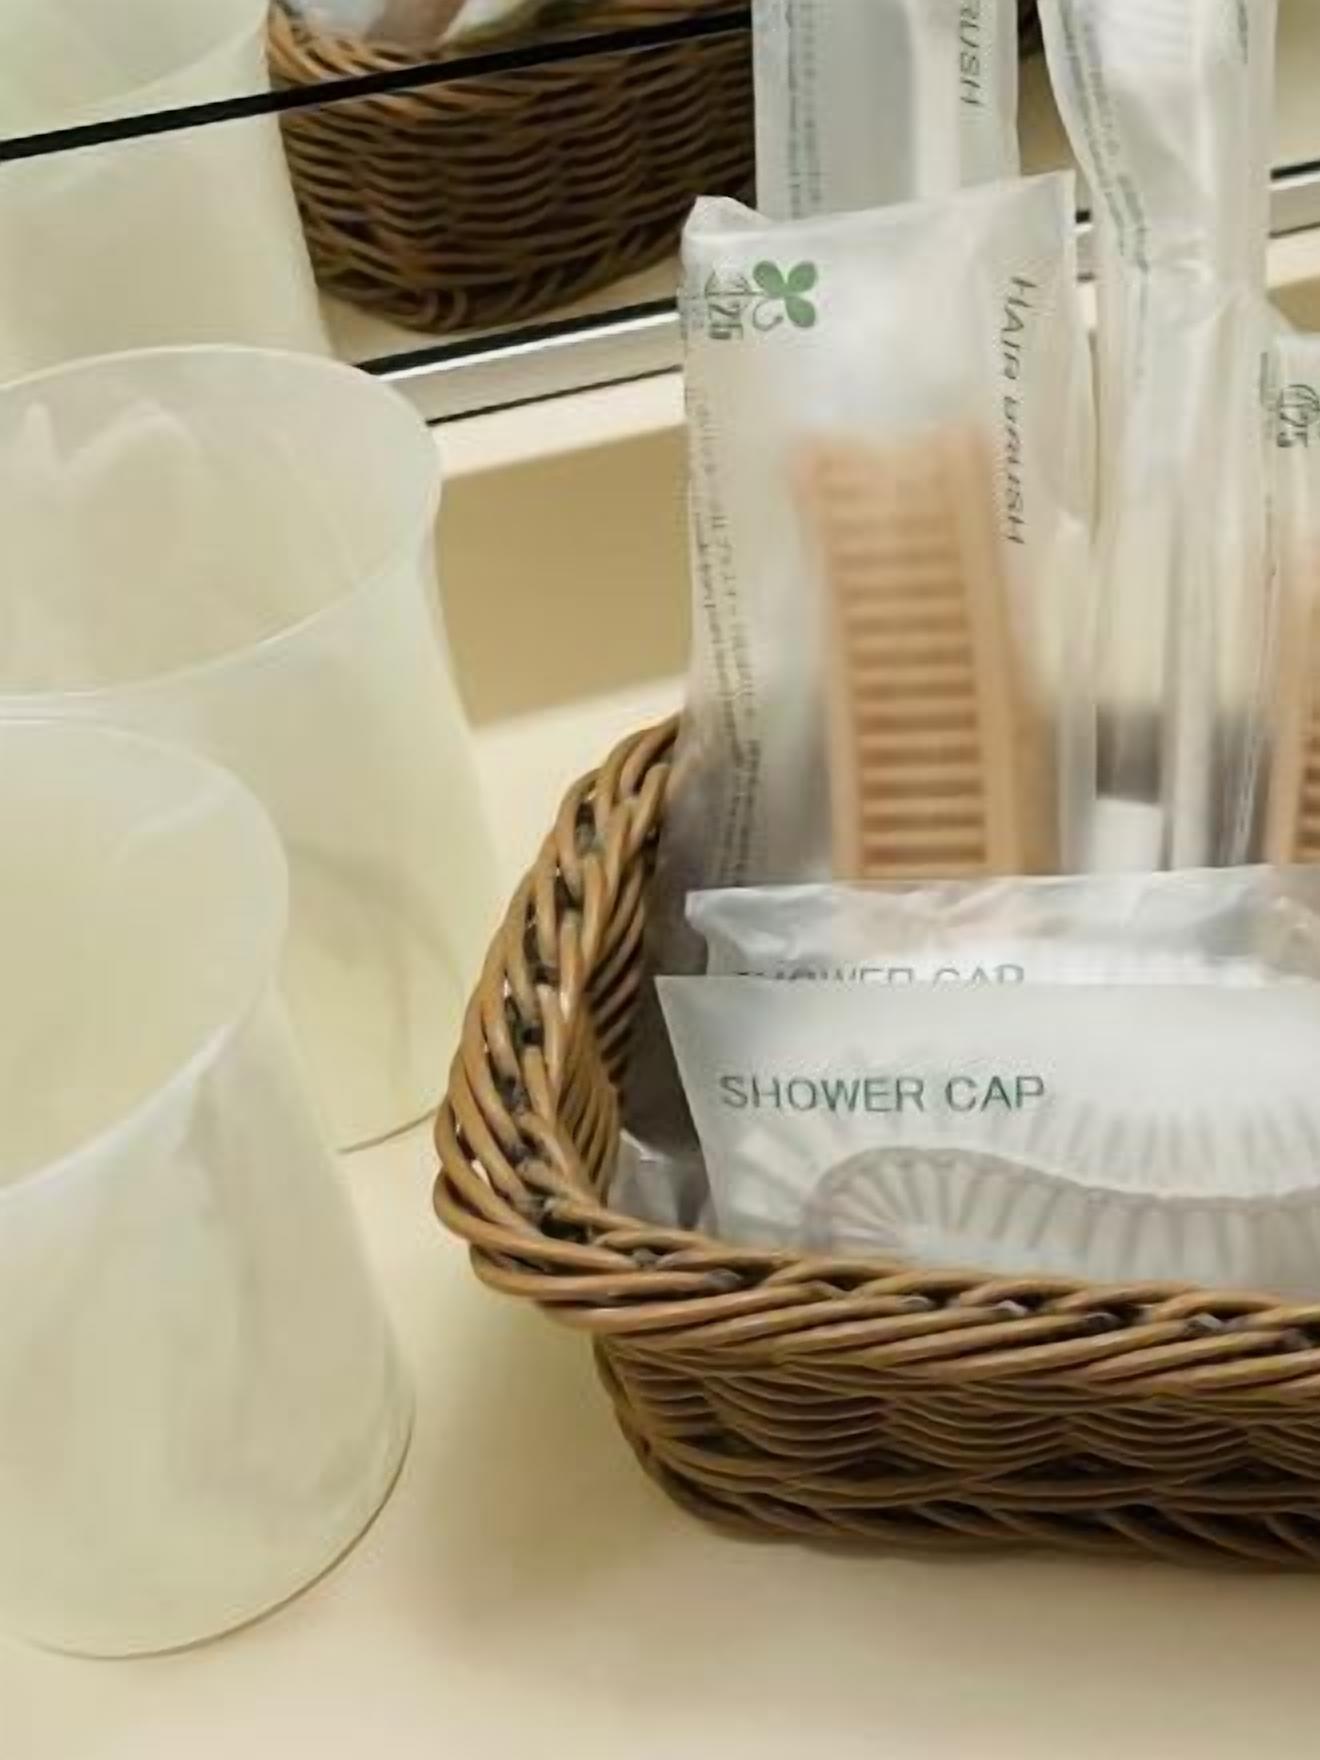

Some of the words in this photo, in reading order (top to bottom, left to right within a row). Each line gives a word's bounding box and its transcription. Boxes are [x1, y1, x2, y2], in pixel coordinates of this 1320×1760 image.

[1002, 276, 1038, 380] HAIR
[719, 1074, 925, 1113] SHOWER
[945, 1074, 1045, 1112] CAP
